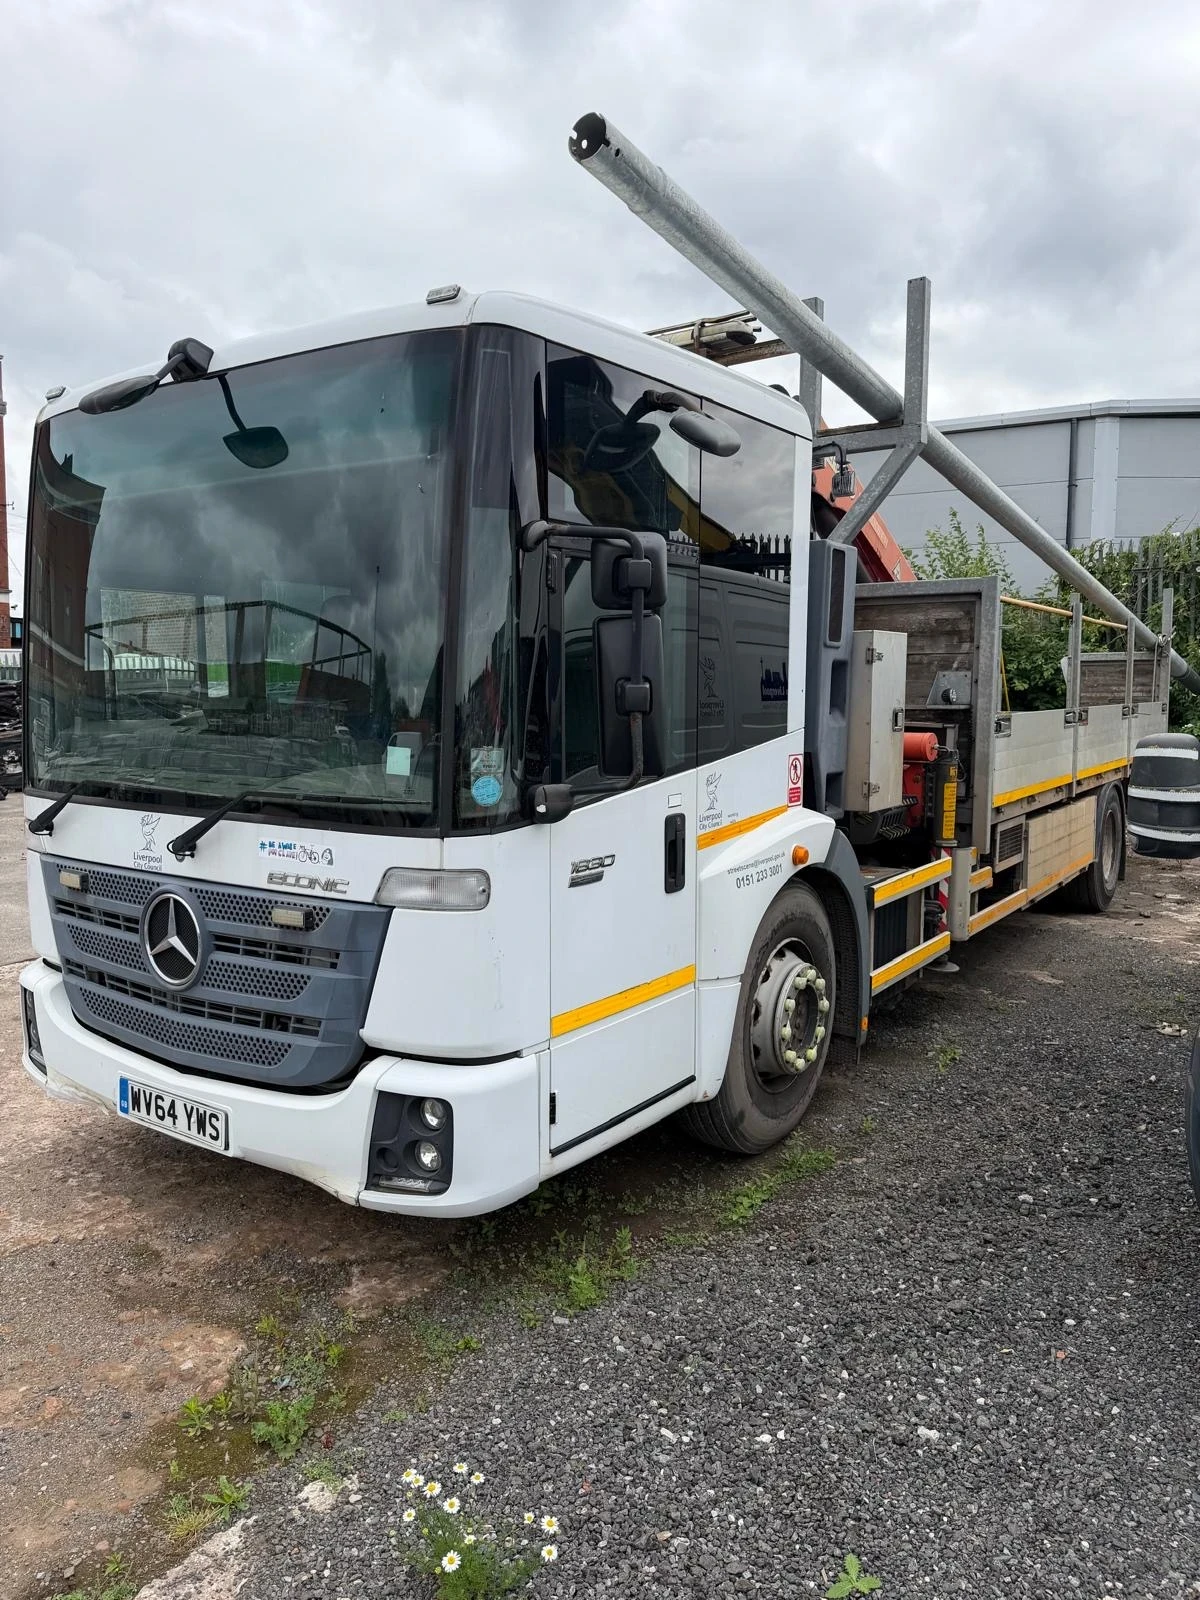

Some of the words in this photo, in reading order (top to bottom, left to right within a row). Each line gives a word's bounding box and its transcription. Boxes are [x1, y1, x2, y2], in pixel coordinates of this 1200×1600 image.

[699, 810, 722, 822] Liverpool
[133, 851, 162, 864] Liverpool
[133, 861, 143, 870] City
[267, 872, 350, 894] ECONIC
[736, 873, 755, 889] 0151
[756, 868, 768, 883] 233
[769, 863, 783, 877] 3001
[131, 1086, 178, 1126] WV64
[184, 1103, 220, 1142] YWS
